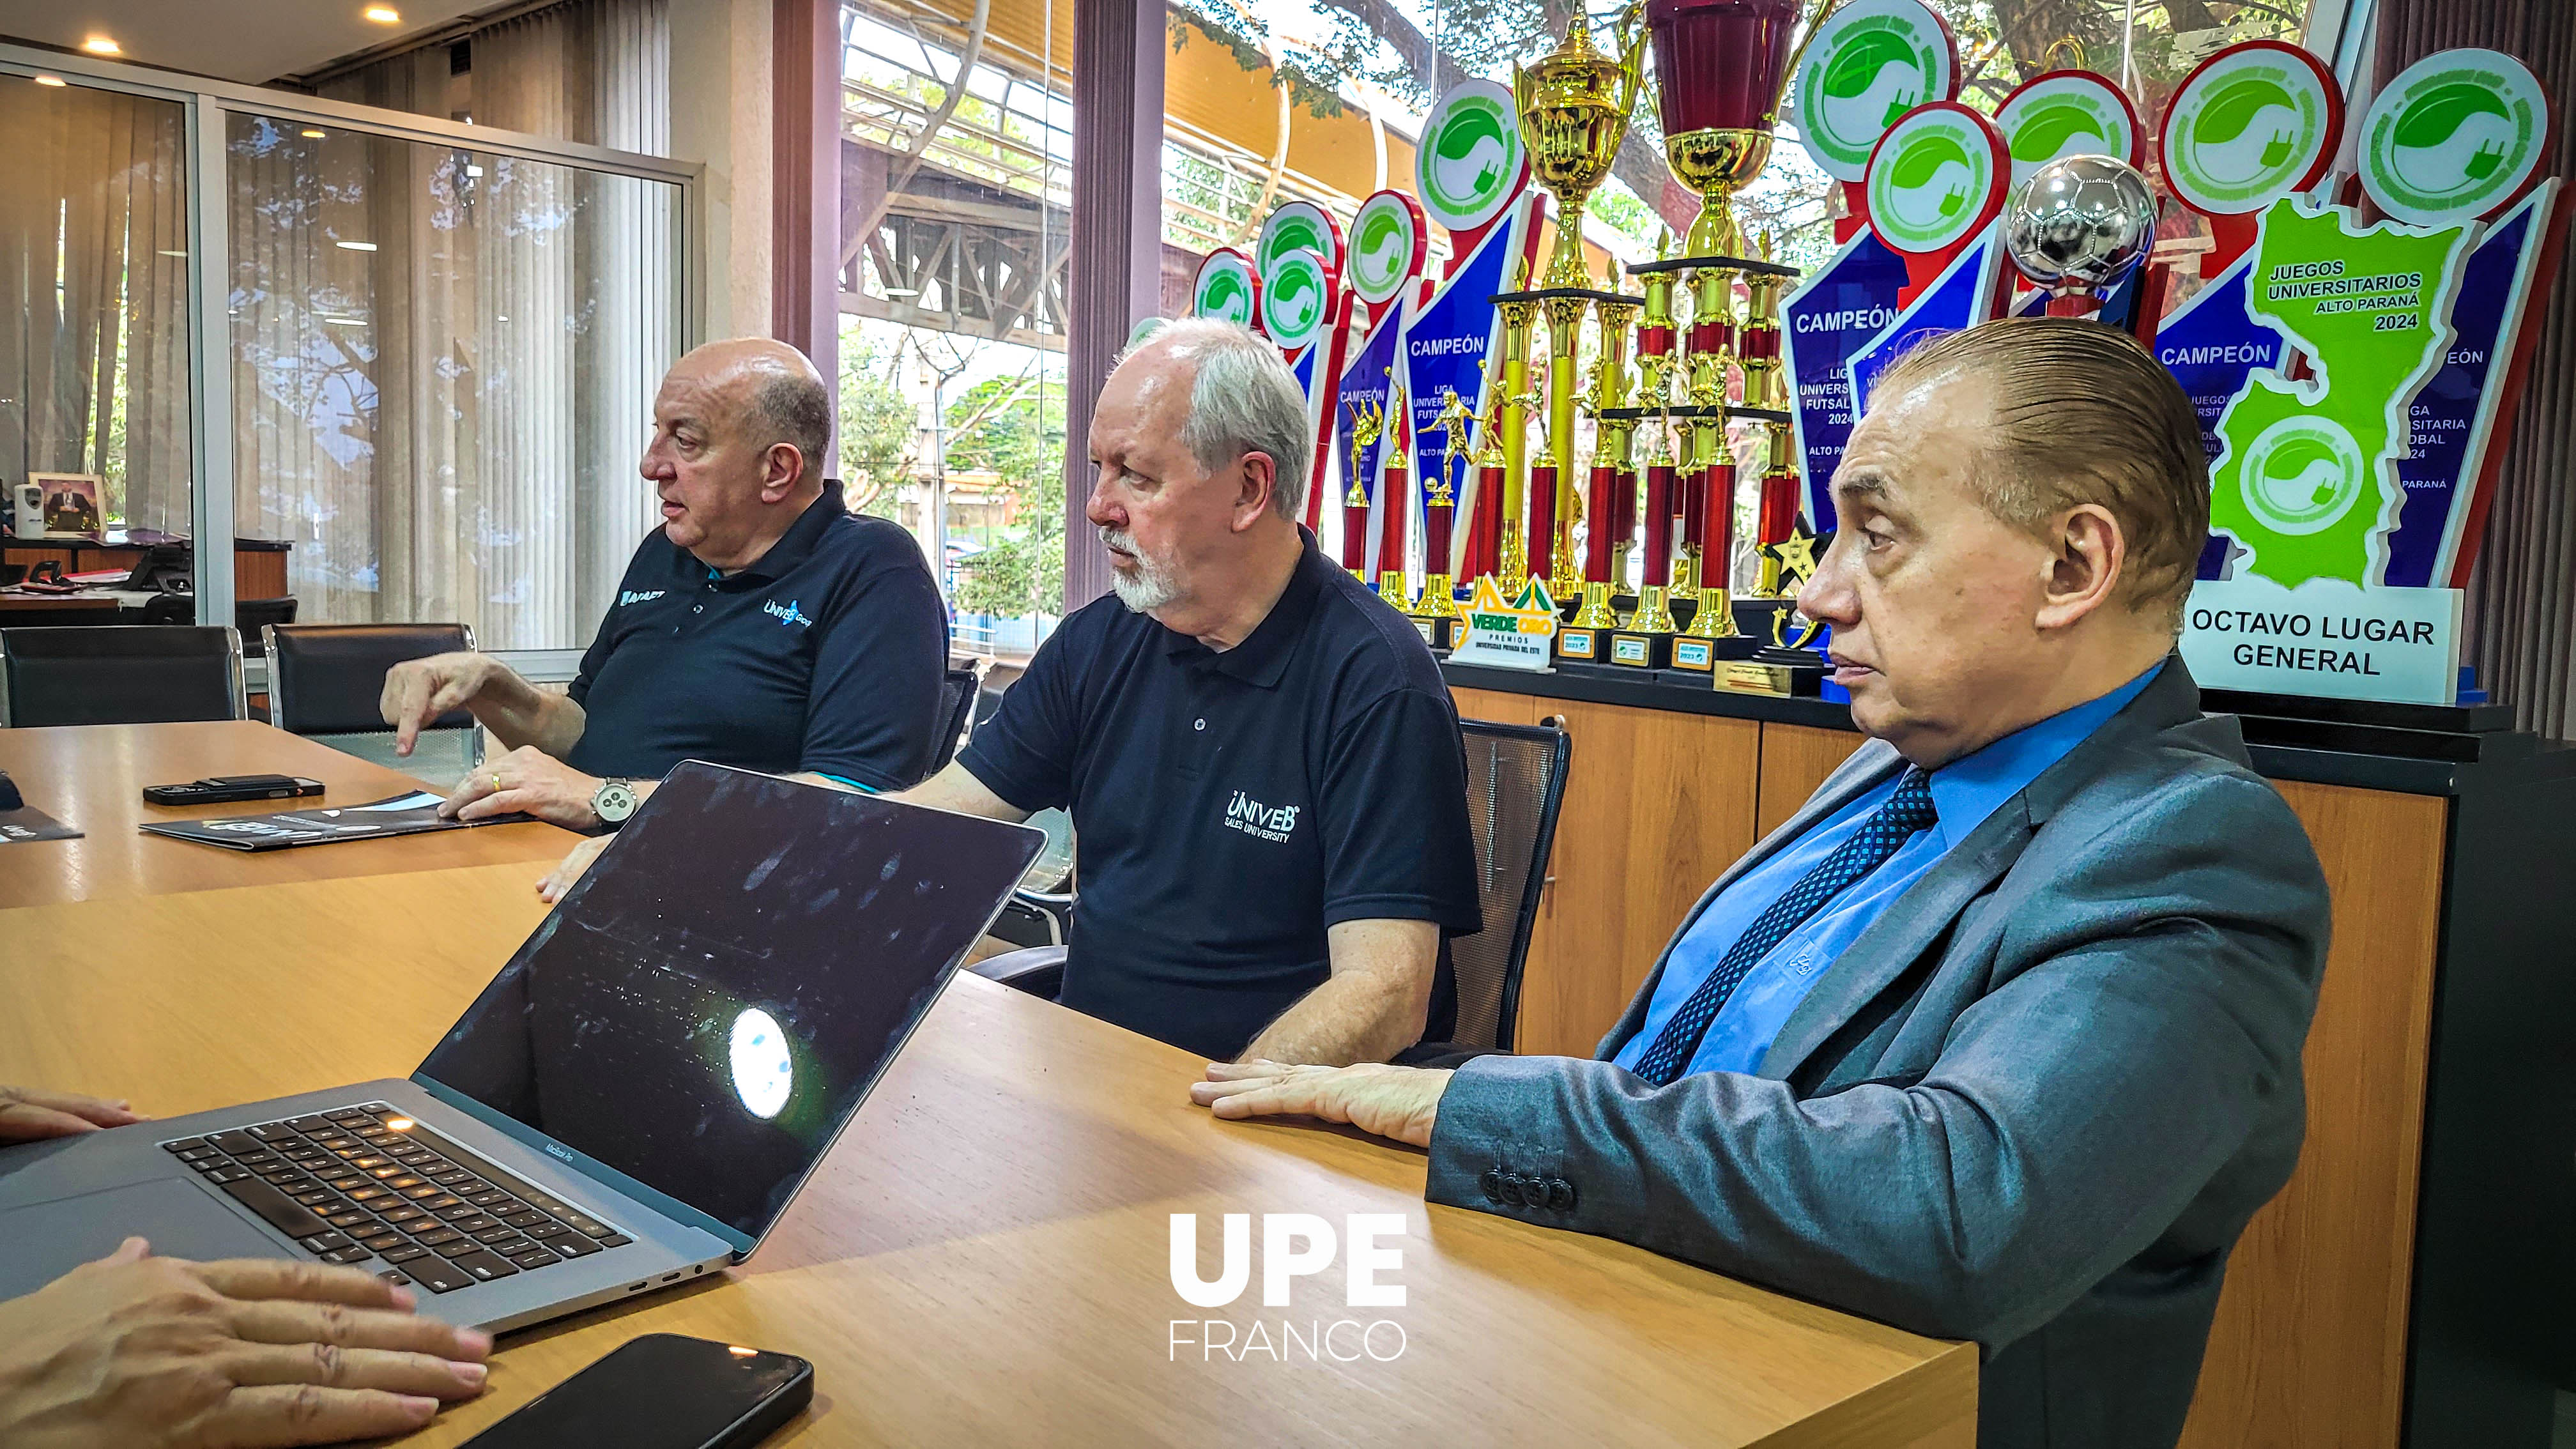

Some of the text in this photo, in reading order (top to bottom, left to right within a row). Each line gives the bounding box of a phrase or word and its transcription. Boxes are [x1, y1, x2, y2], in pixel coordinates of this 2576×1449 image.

[2270, 261, 2344, 280] JUEGOS
[2269, 273, 2421, 299] UNIVERSITARIOS
[2315, 293, 2419, 313] ALTO PARANÁ
[2375, 314, 2418, 331] 2024
[1411, 334, 1483, 356] CAMPEÓN
[2162, 342, 2270, 365] CAMPEÓN
[1830, 368, 1847, 379] LIG
[1340, 387, 1384, 403] CAMPEÓN
[1800, 383, 1848, 395] UNIVERS
[1806, 398, 1850, 410] FUTSAL
[2411, 406, 2430, 415] GA
[1828, 413, 1853, 424] 2024
[2412, 419, 2465, 430] SITARIA
[1809, 446, 1832, 456] ALTO
[2411, 449, 2425, 459] 24
[2402, 479, 2446, 488] PARANÁ
[1471, 613, 1552, 636] VERDE ORO
[2193, 610, 2434, 645] OCTAVO LUGAR
[2234, 644, 2380, 675] GENERAL
[1225, 816, 1290, 843] SALES UNIVERSITY
